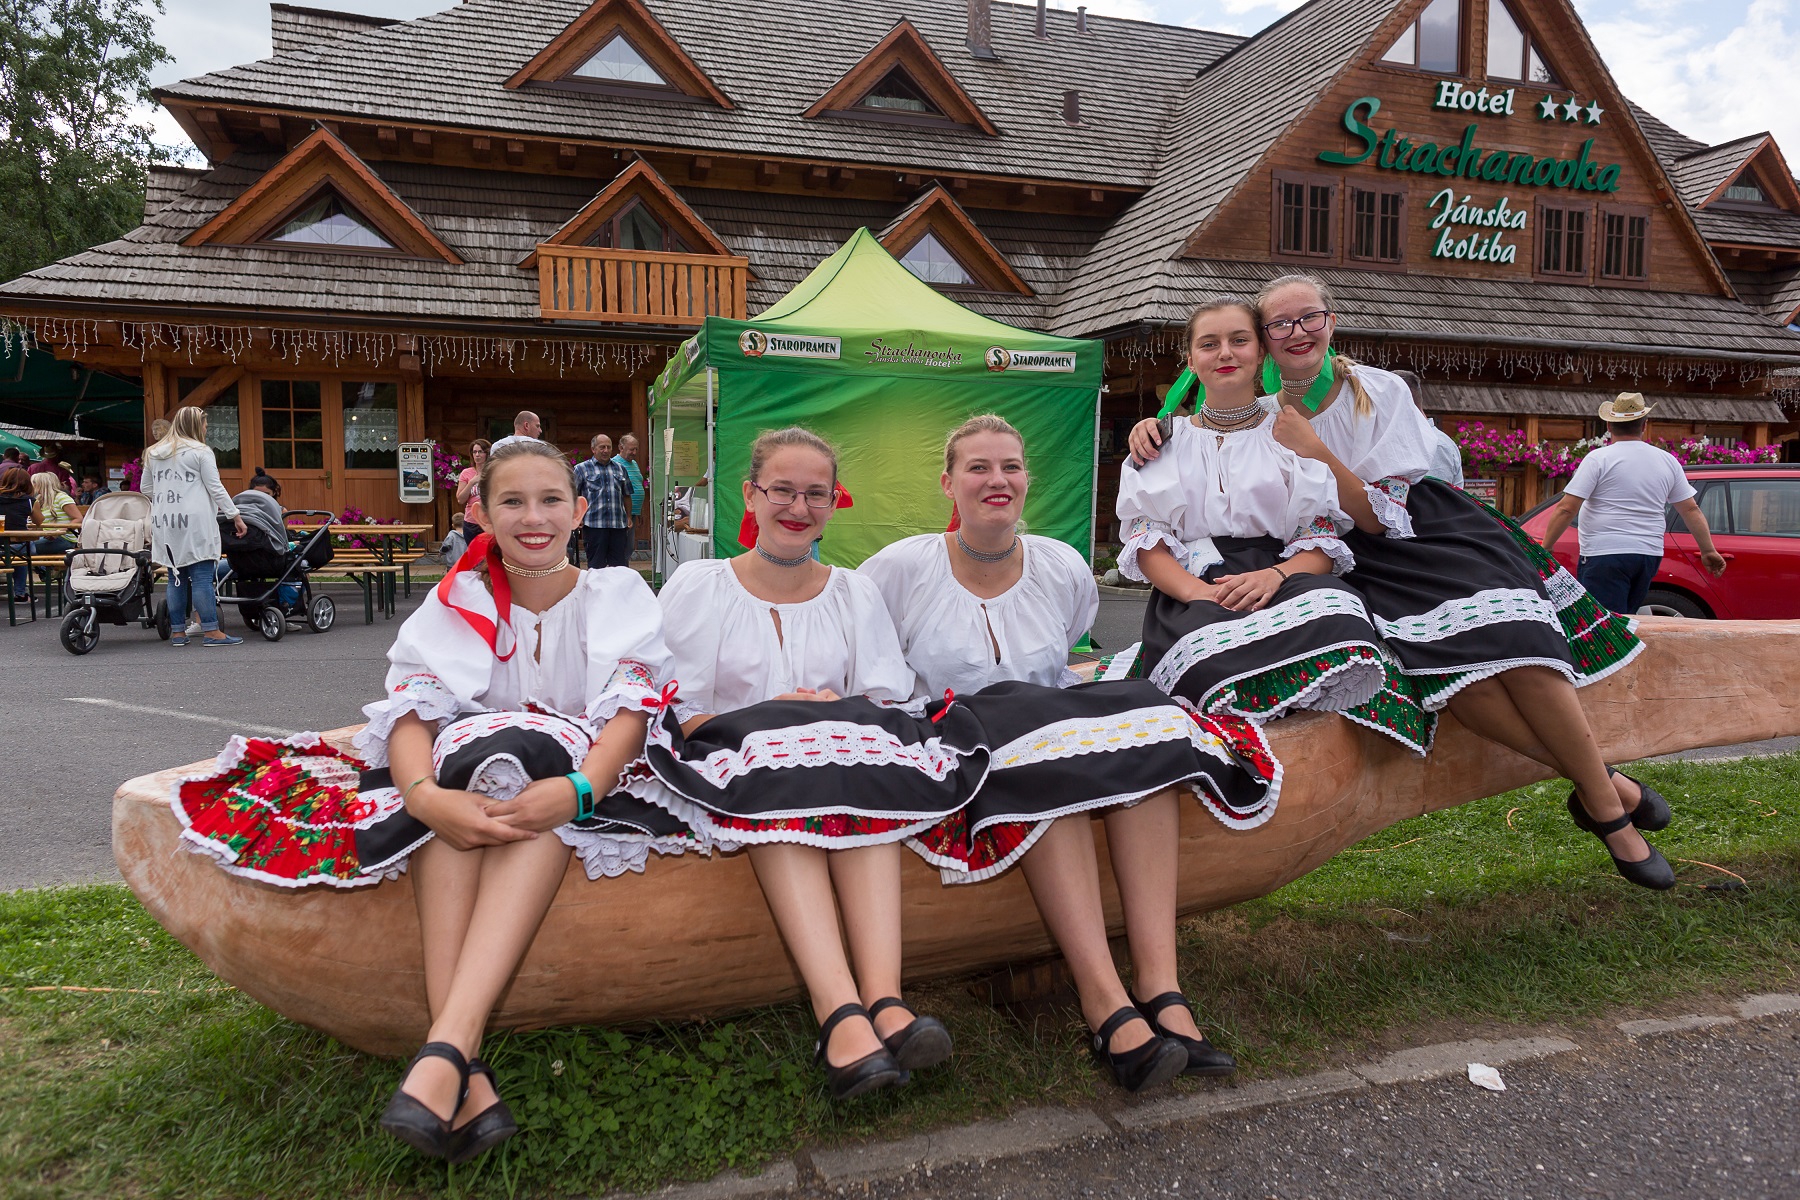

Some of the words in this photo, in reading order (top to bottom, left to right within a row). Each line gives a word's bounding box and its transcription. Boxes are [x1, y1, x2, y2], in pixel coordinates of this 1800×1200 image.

[1436, 80, 1515, 116] Hotel
[1318, 96, 1622, 193] Strachanovka
[1428, 187, 1528, 230] Jánska
[1435, 226, 1517, 264] koliba
[770, 337, 837, 354] STAROPRAMEN
[864, 338, 962, 361] Strachanovka
[924, 357, 951, 368] Hotel
[1013, 353, 1073, 368] STAROPRAMEN
